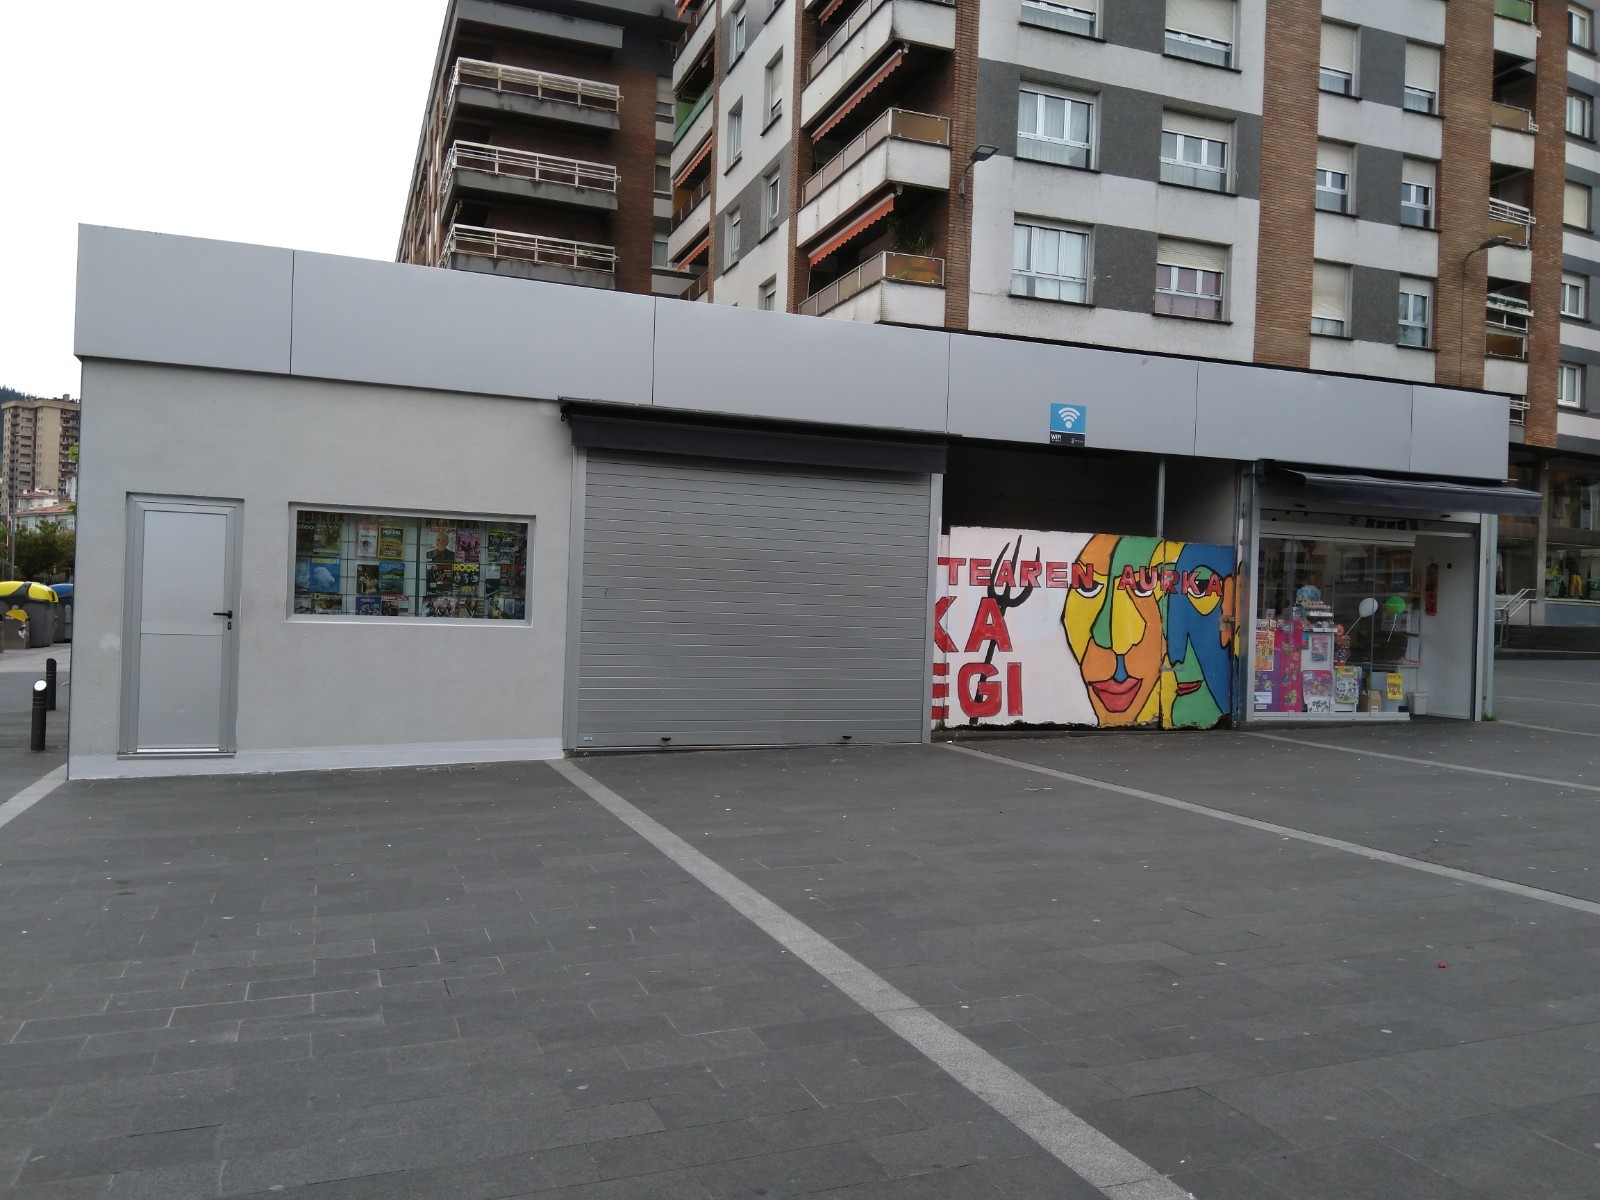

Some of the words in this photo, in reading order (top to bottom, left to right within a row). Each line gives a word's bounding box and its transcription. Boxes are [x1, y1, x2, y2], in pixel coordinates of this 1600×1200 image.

[453, 563, 479, 572] ROCK
[938, 557, 1094, 589] TEAREN
[1118, 565, 1224, 596] AURKA
